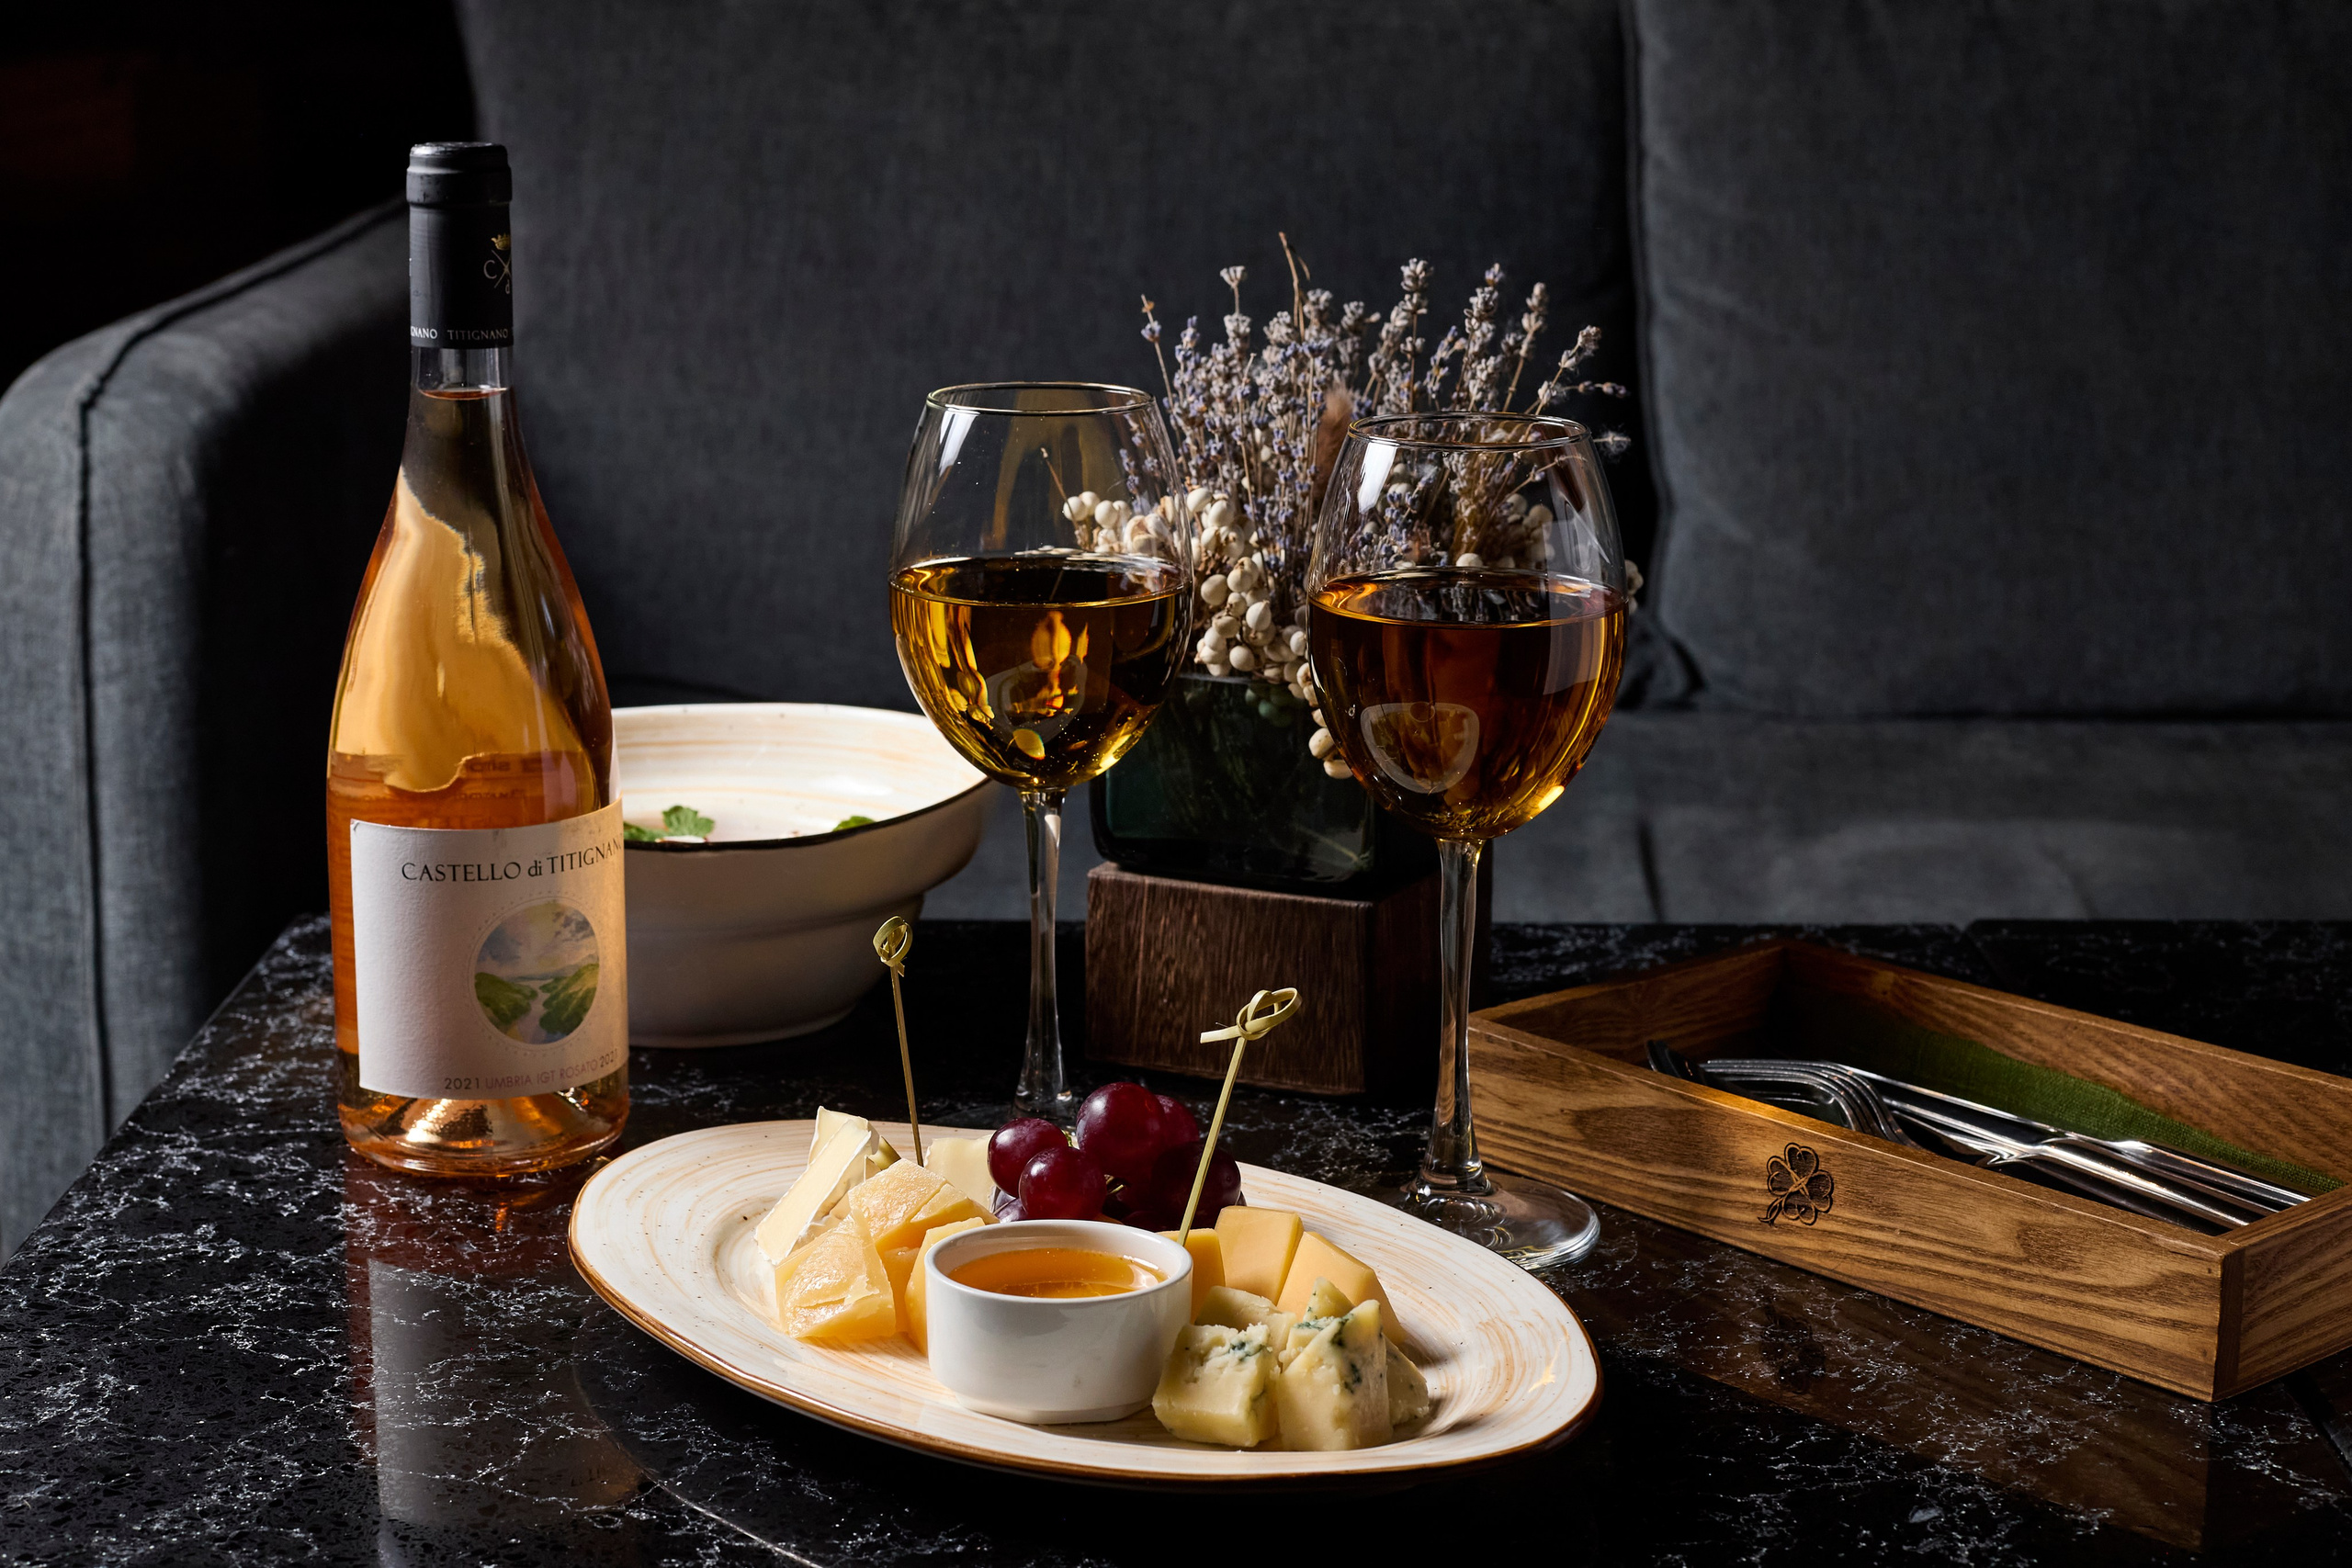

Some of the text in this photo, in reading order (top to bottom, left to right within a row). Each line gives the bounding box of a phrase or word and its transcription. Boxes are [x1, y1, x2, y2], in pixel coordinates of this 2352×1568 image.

[447, 328, 509, 341] TITIGNANO
[401, 836, 622, 883] CASTELLO di TITIGNAN
[444, 1077, 480, 1090] 2021
[484, 1075, 533, 1090] UMBRIA
[537, 1069, 556, 1084] IGT
[559, 1059, 598, 1080] ROSATO
